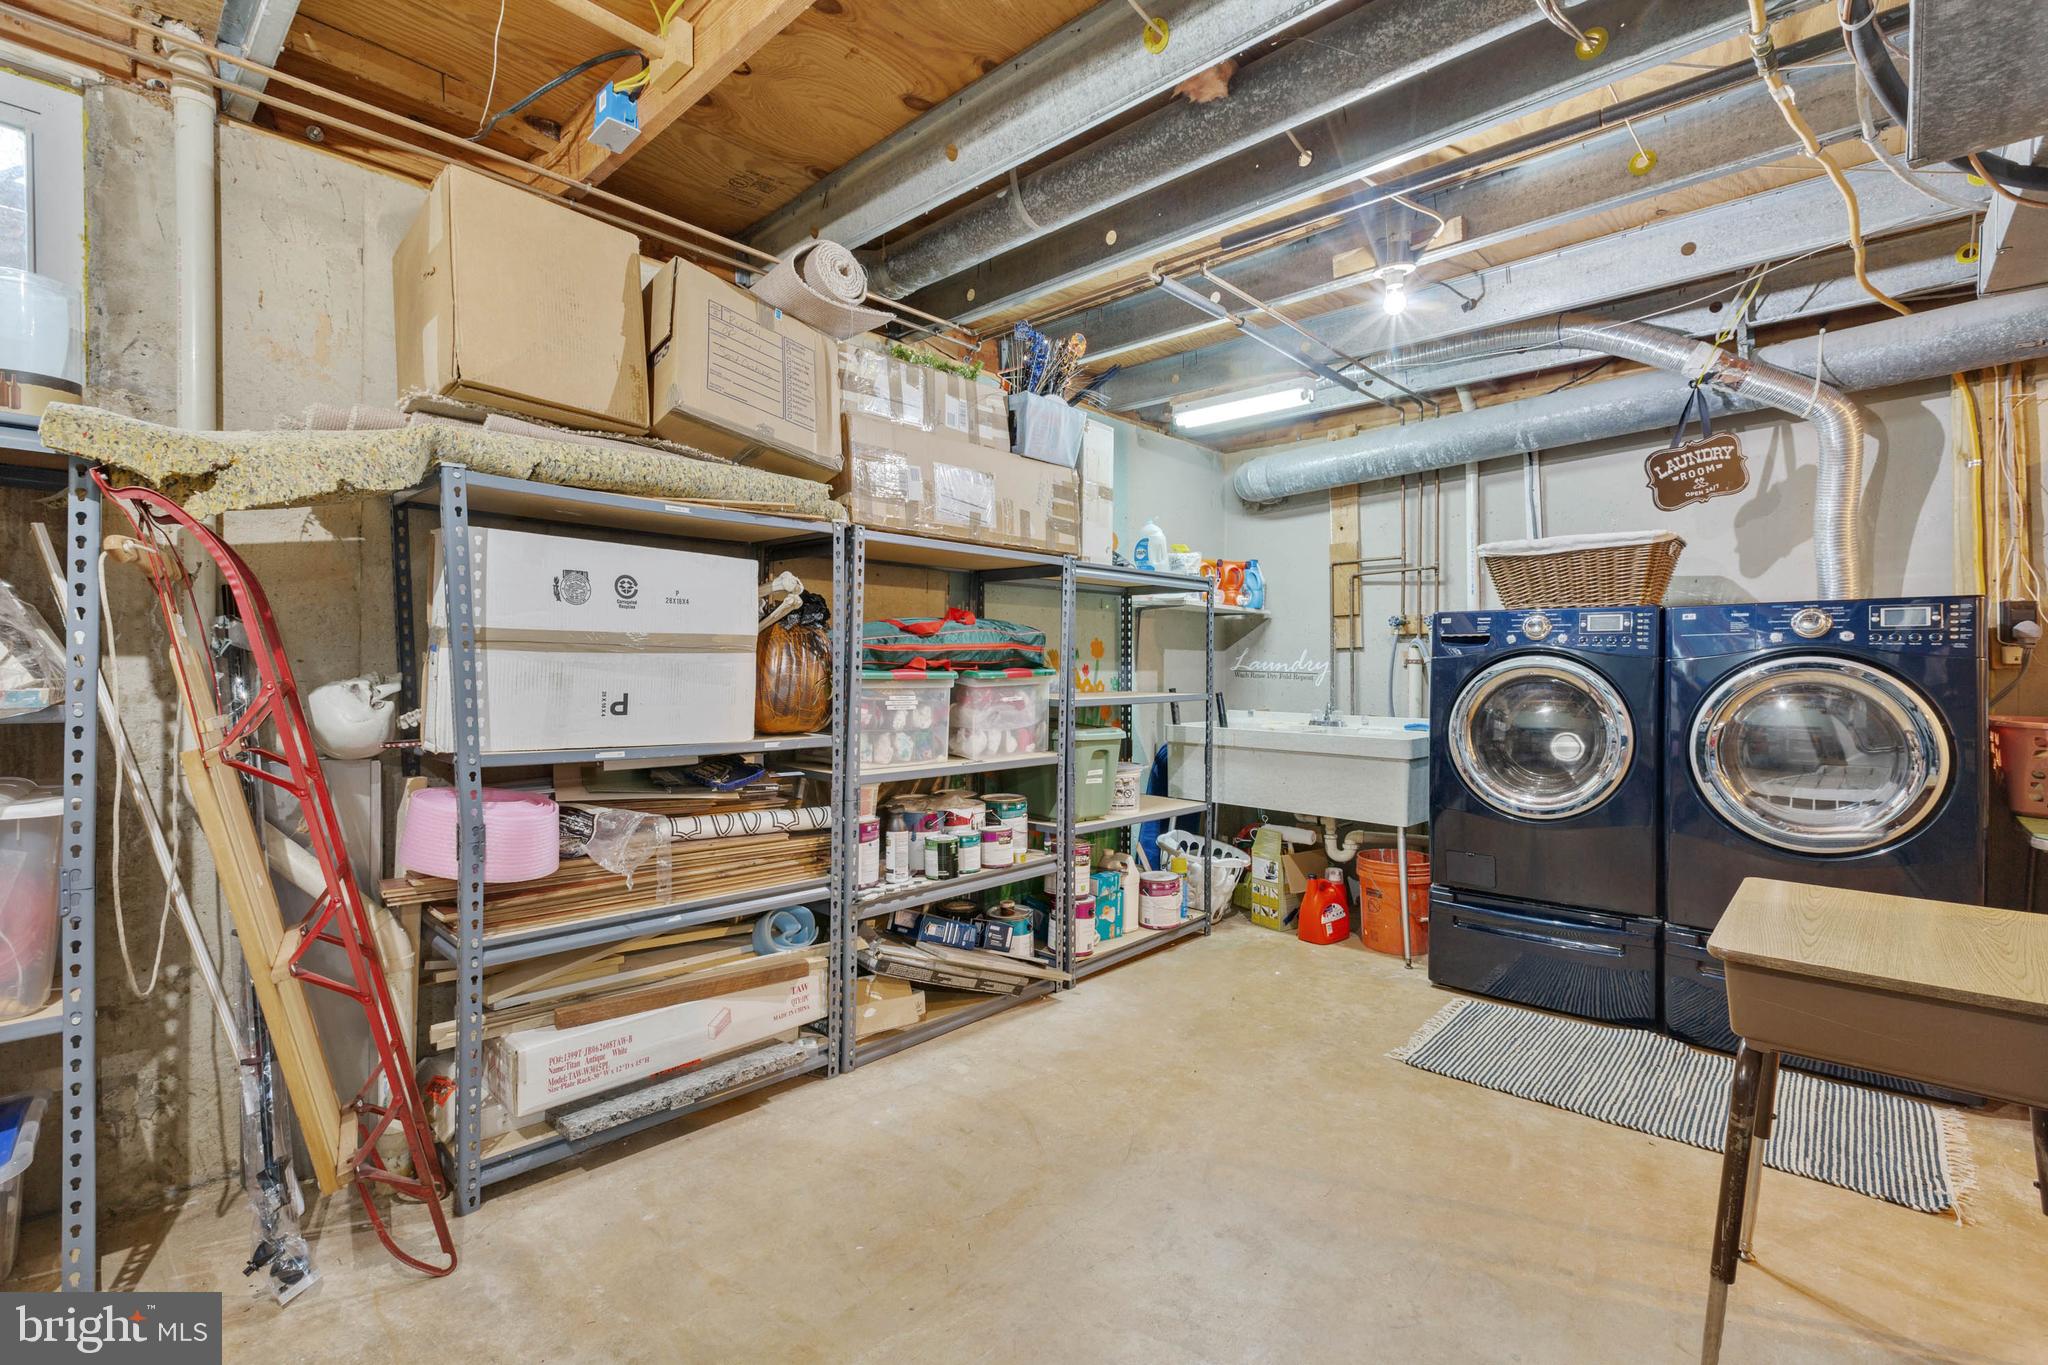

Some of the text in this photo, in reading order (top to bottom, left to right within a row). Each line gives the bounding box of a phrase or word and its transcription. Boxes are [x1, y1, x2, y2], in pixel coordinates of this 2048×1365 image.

[1653, 445, 1735, 480] LAUNDRY
[1680, 463, 1716, 481] ROOM
[1705, 483, 1720, 494] 24/7
[1230, 647, 1331, 687] Laundry
[610, 692, 628, 715] P
[791, 983, 807, 995] TAW
[585, 1053, 606, 1065] Antique
[611, 1047, 628, 1057] White
